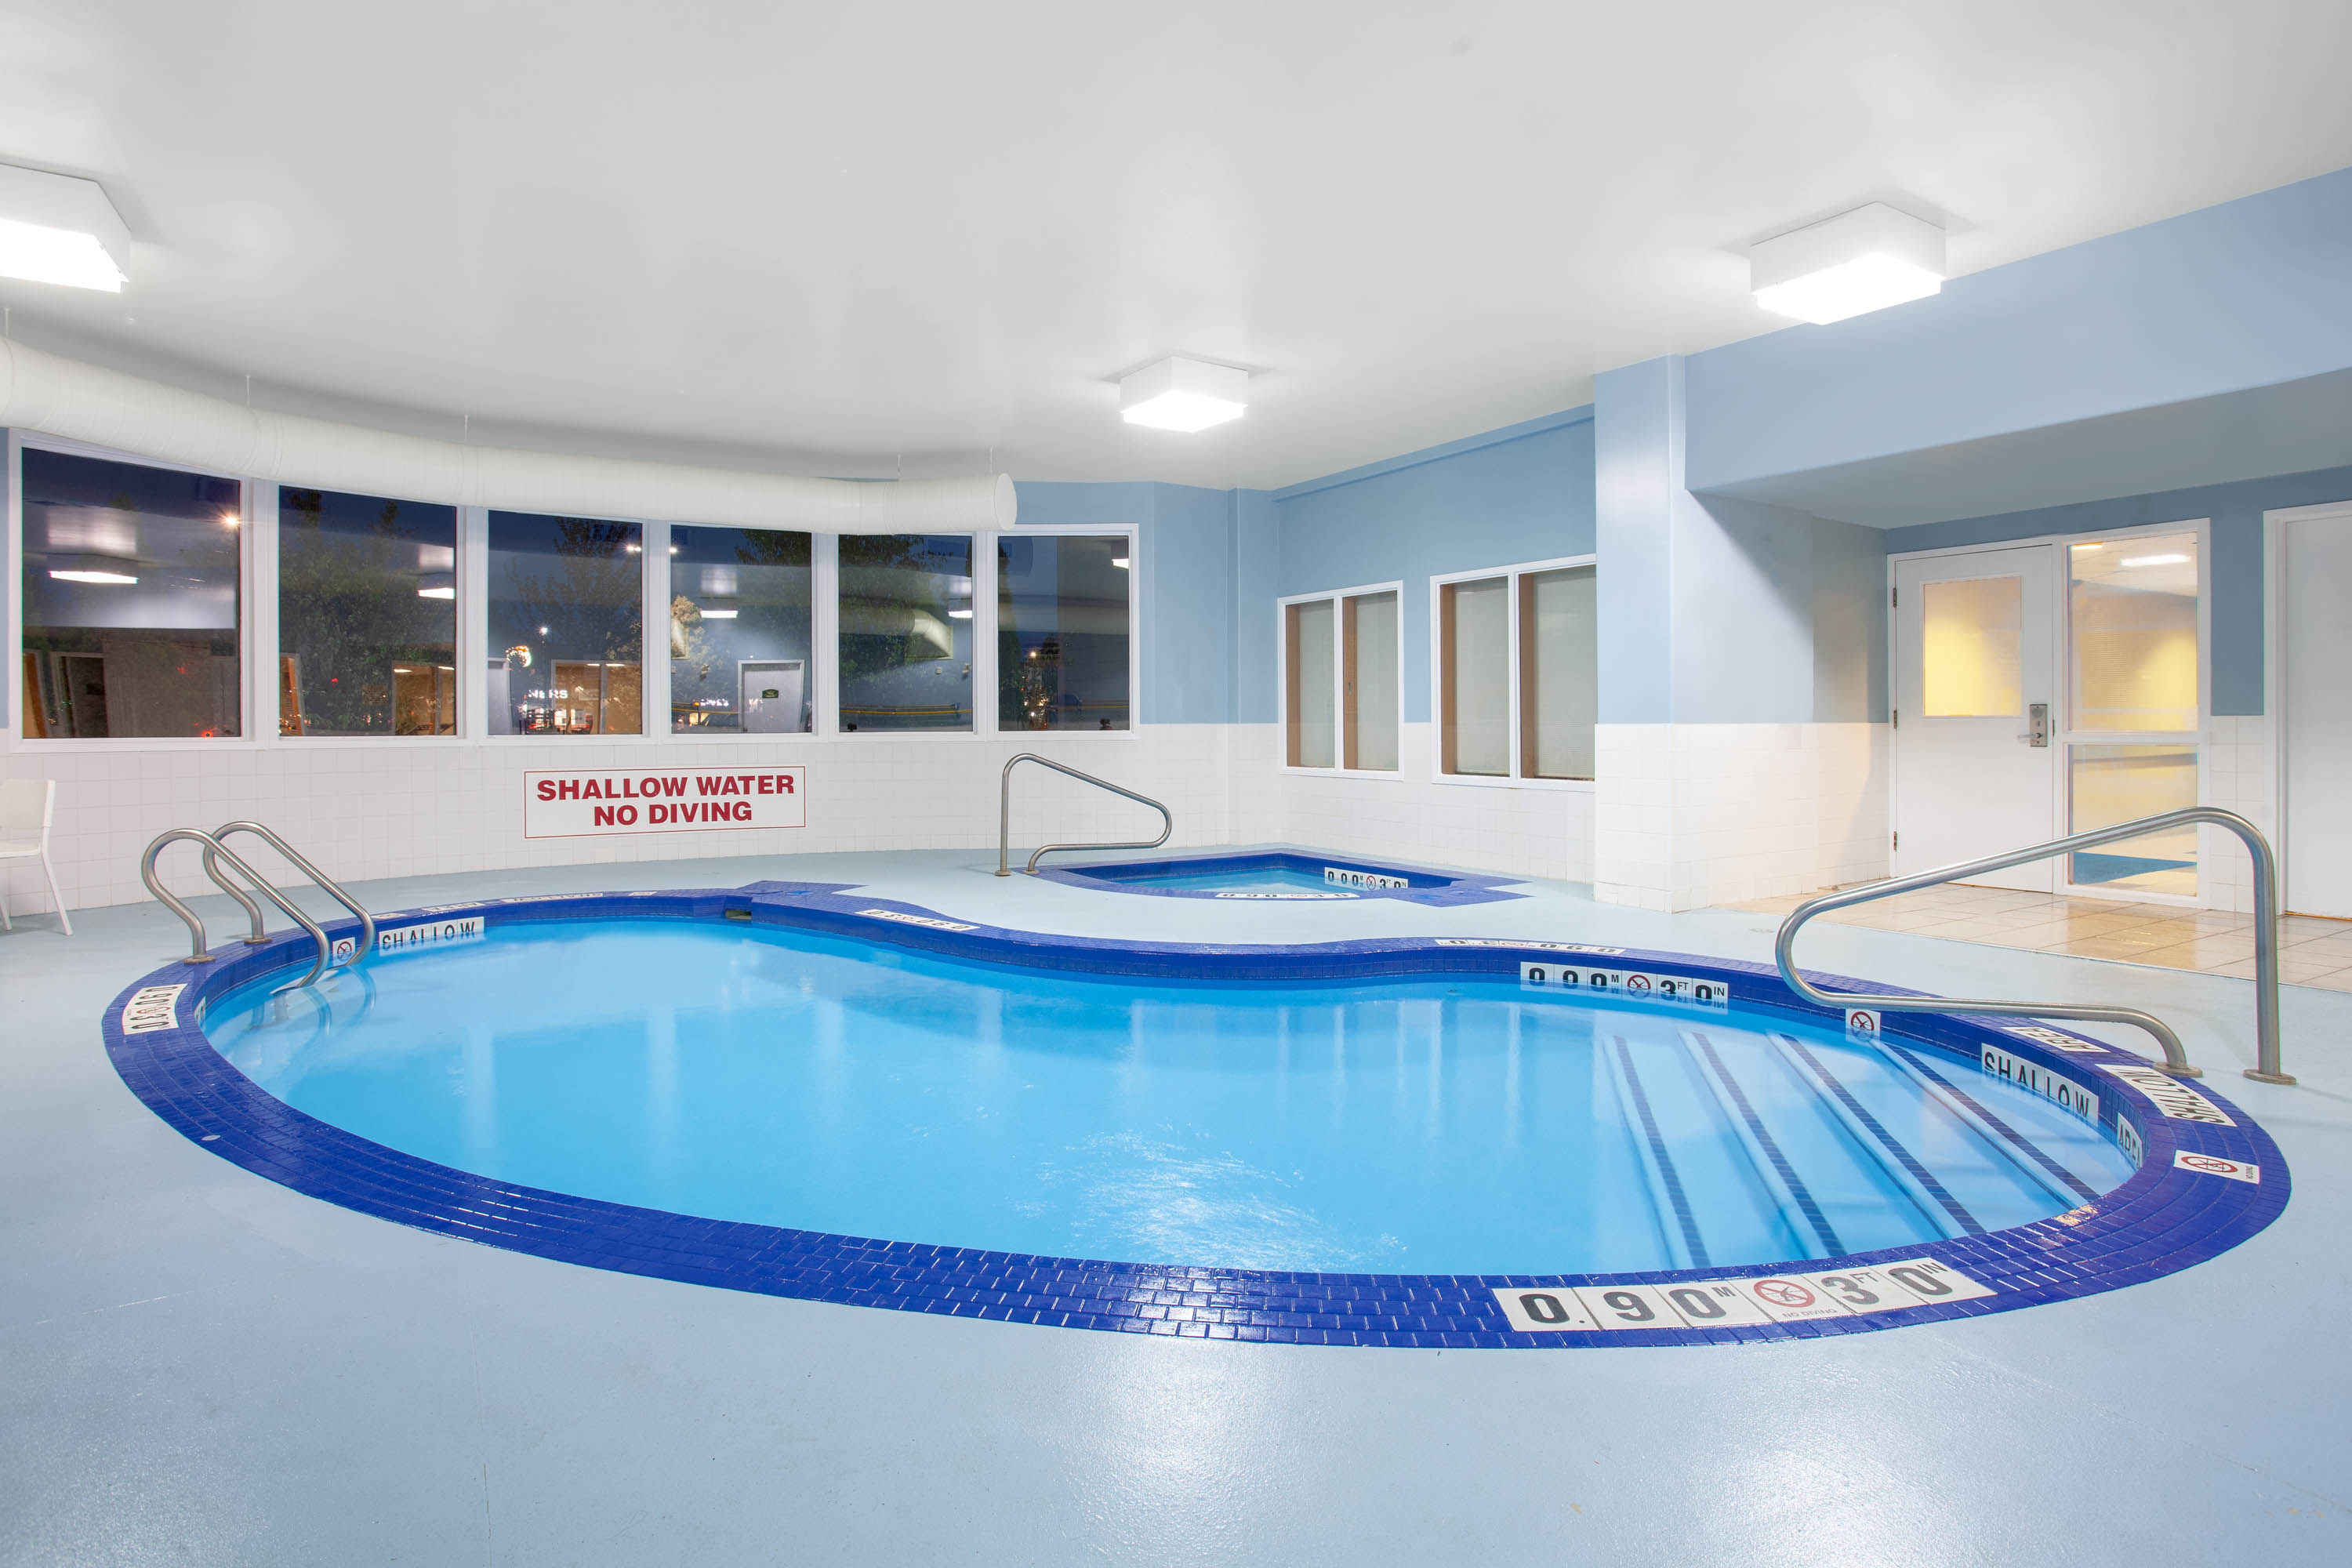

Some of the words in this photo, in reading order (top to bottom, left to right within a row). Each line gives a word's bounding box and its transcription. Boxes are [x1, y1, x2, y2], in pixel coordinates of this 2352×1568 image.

[537, 777, 688, 801] SHALLOW
[696, 775, 795, 796] WATER
[594, 805, 638, 826] NO
[649, 801, 753, 824] DIVING
[1984, 1051, 2089, 1117] SHALLOW
